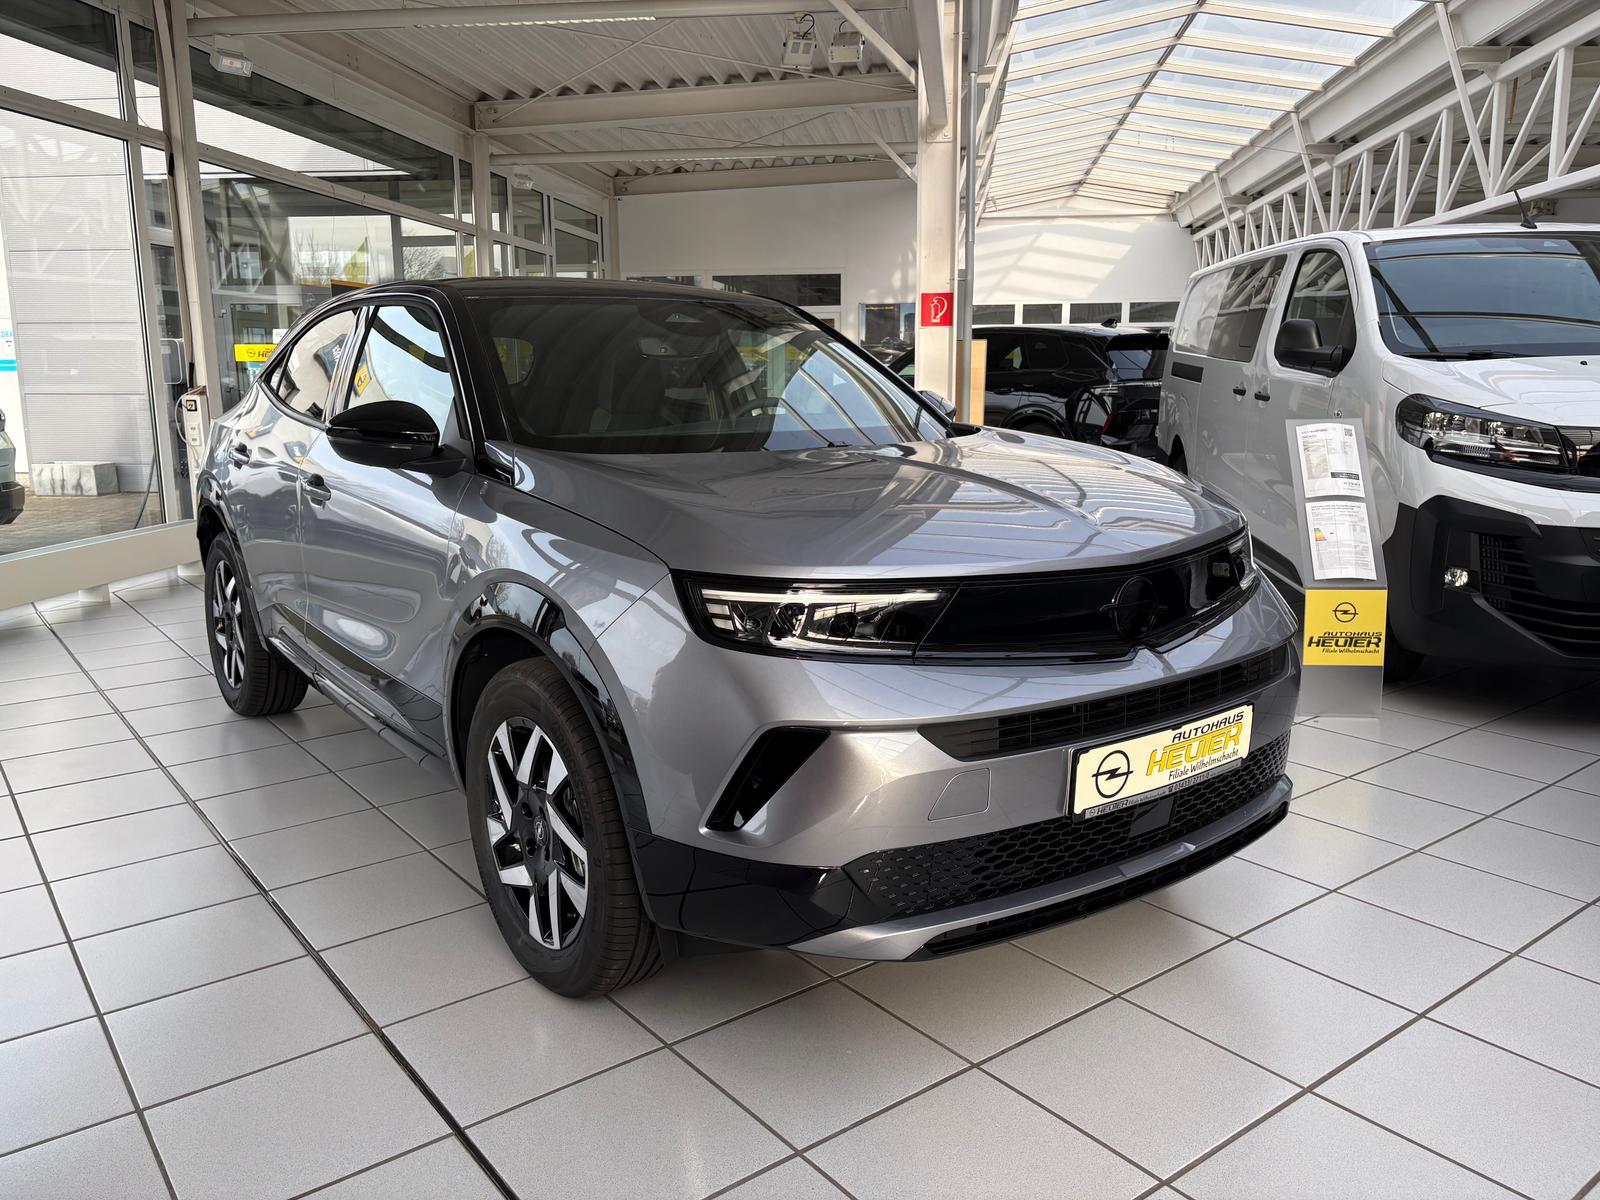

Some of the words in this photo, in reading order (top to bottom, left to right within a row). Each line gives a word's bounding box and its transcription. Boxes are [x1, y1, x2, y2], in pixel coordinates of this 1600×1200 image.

[1307, 636, 1382, 648] HEUTER
[1172, 711, 1245, 743] AUTOHAUS
[1146, 722, 1243, 776] HEUTER
[1168, 765, 1190, 781] Filiale
[1190, 748, 1239, 774] Wilhelmschacht
